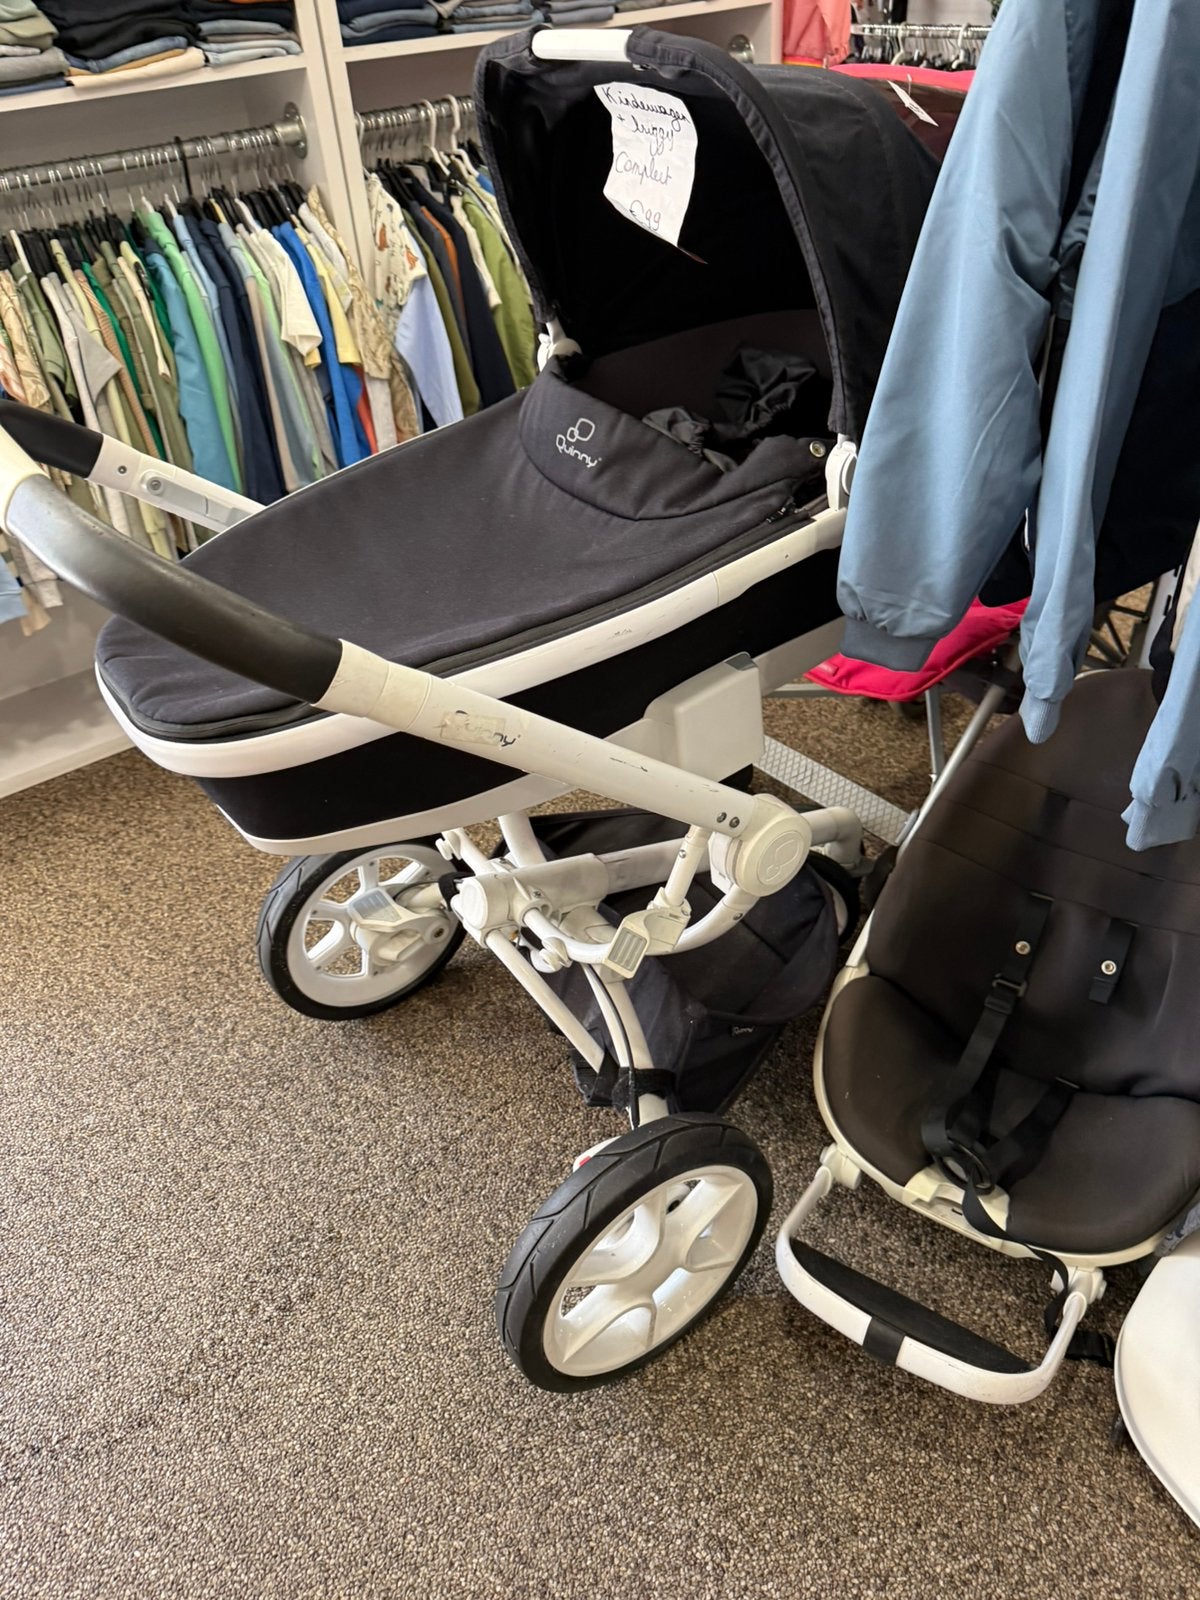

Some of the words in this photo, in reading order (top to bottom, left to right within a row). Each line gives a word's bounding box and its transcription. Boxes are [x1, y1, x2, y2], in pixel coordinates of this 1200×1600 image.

[616, 113, 626, 122] +
[631, 114, 674, 157] buggy
[555, 433, 598, 468] Quinny
[454, 709, 517, 748] uinny
